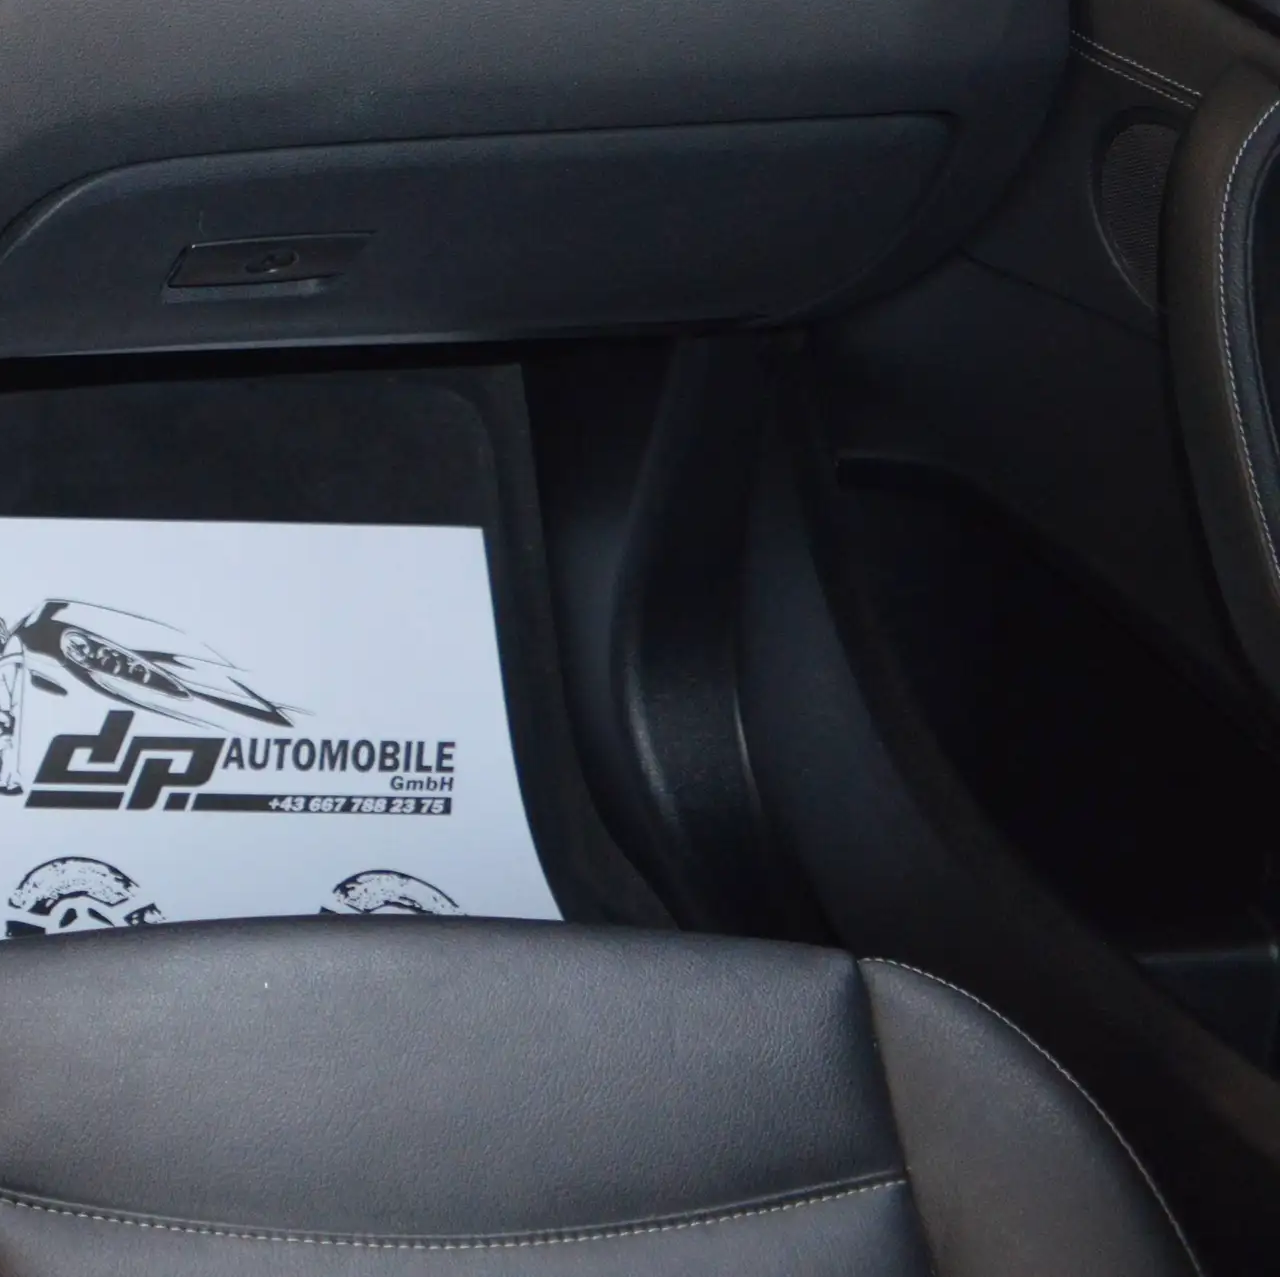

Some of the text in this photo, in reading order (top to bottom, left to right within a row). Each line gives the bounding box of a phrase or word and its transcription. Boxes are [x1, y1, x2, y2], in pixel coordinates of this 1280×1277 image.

[222, 737, 456, 773] AUTOMOBILE
[389, 776, 454, 792] GmbH
[268, 796, 444, 813] +43 667 788 23 75
